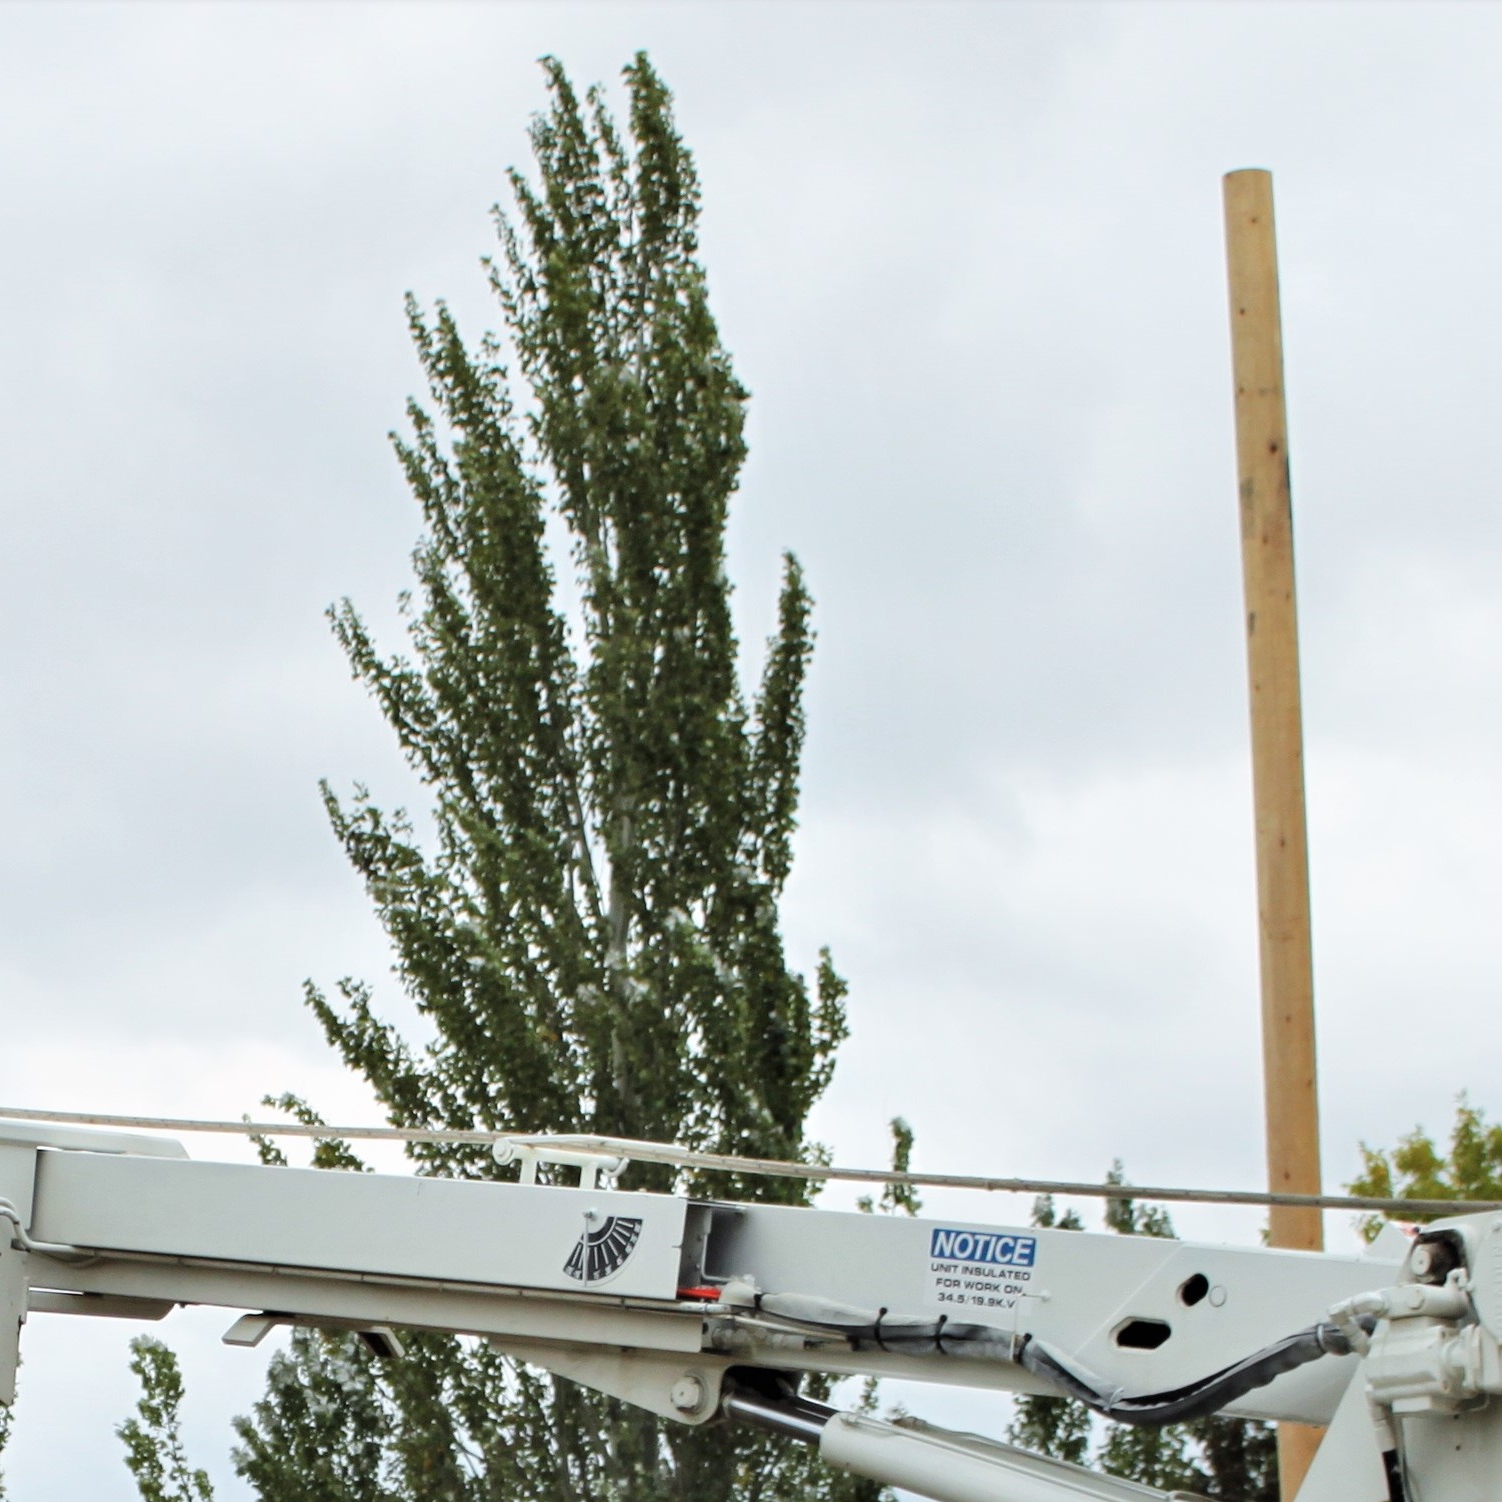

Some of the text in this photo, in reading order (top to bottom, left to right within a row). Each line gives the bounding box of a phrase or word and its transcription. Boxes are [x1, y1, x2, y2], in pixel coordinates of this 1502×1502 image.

[933, 1231, 1033, 1265] NOTICE
[931, 1263, 1031, 1281] UNIT INSULATED
[936, 1278, 1023, 1294] FOR WORK ON
